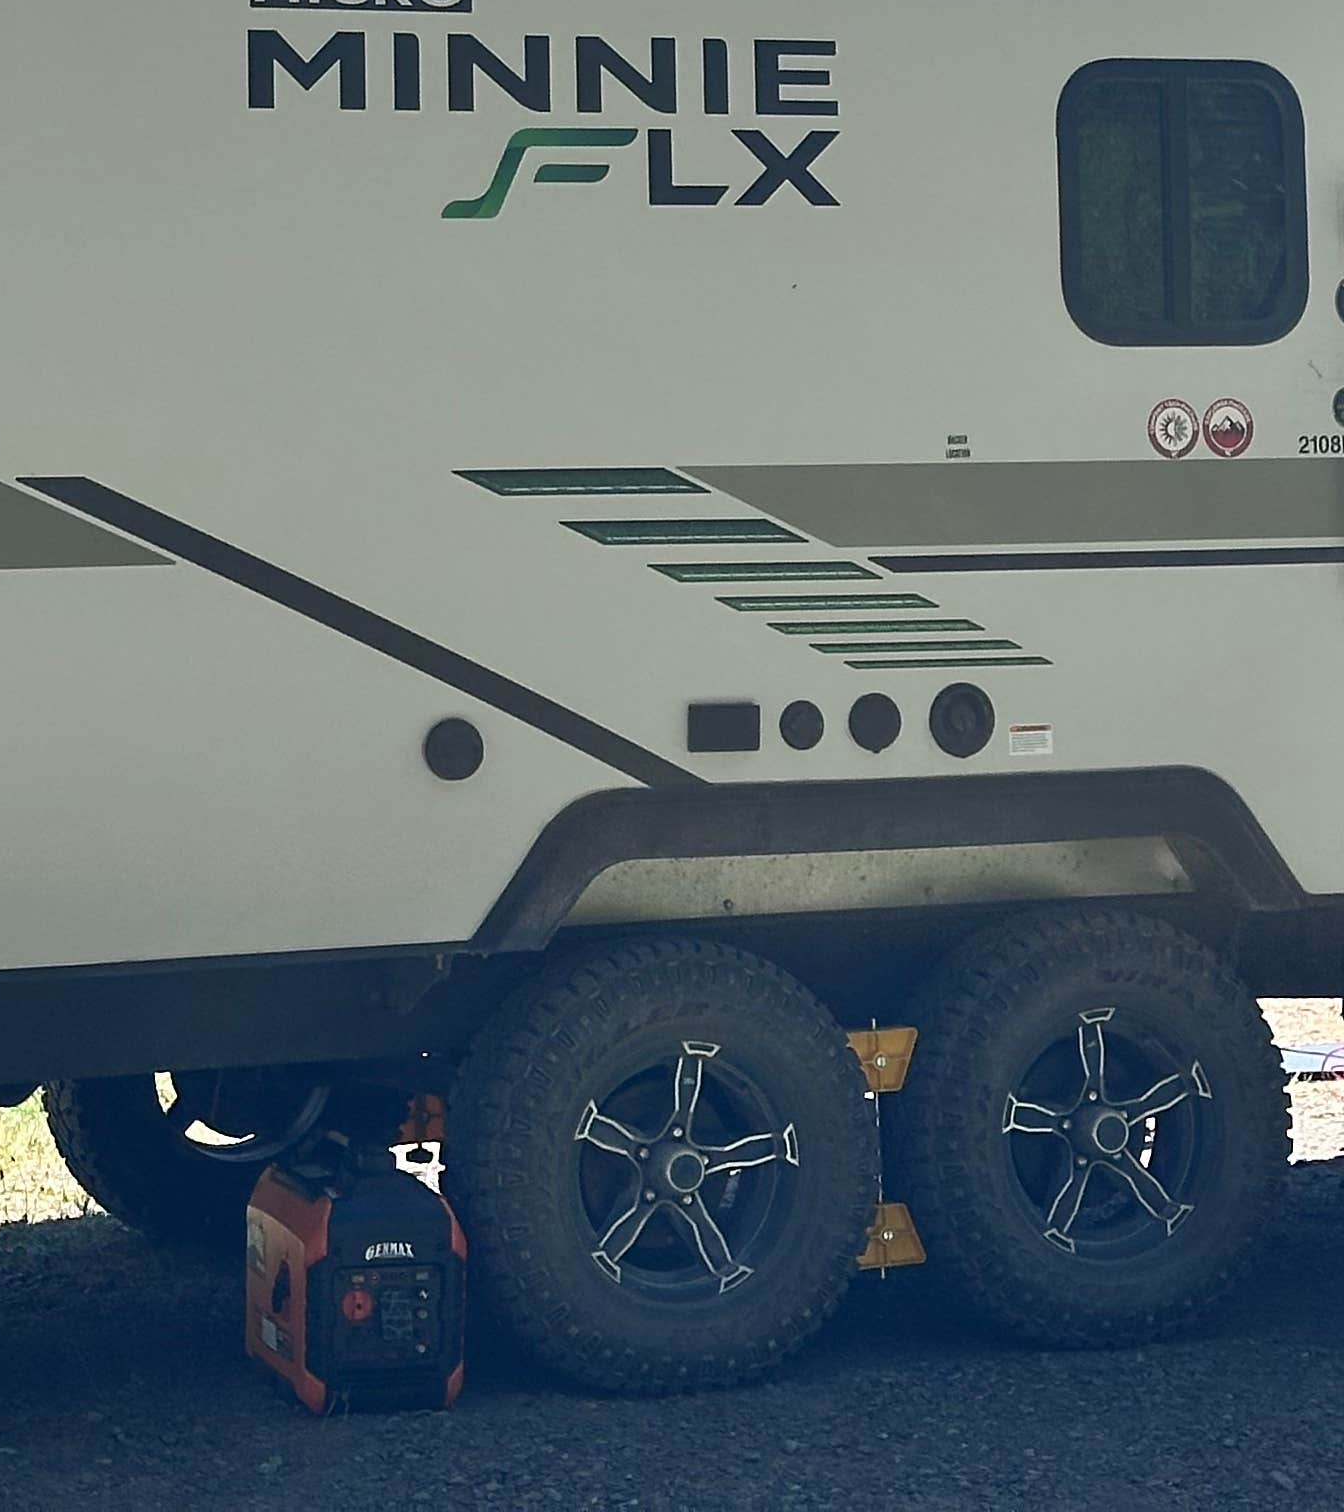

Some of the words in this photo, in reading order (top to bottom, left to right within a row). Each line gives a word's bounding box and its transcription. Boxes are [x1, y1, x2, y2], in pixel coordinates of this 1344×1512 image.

[247, 28, 840, 116] MINNIE
[440, 127, 841, 219] FLX
[364, 1241, 416, 1262] GENMAX
